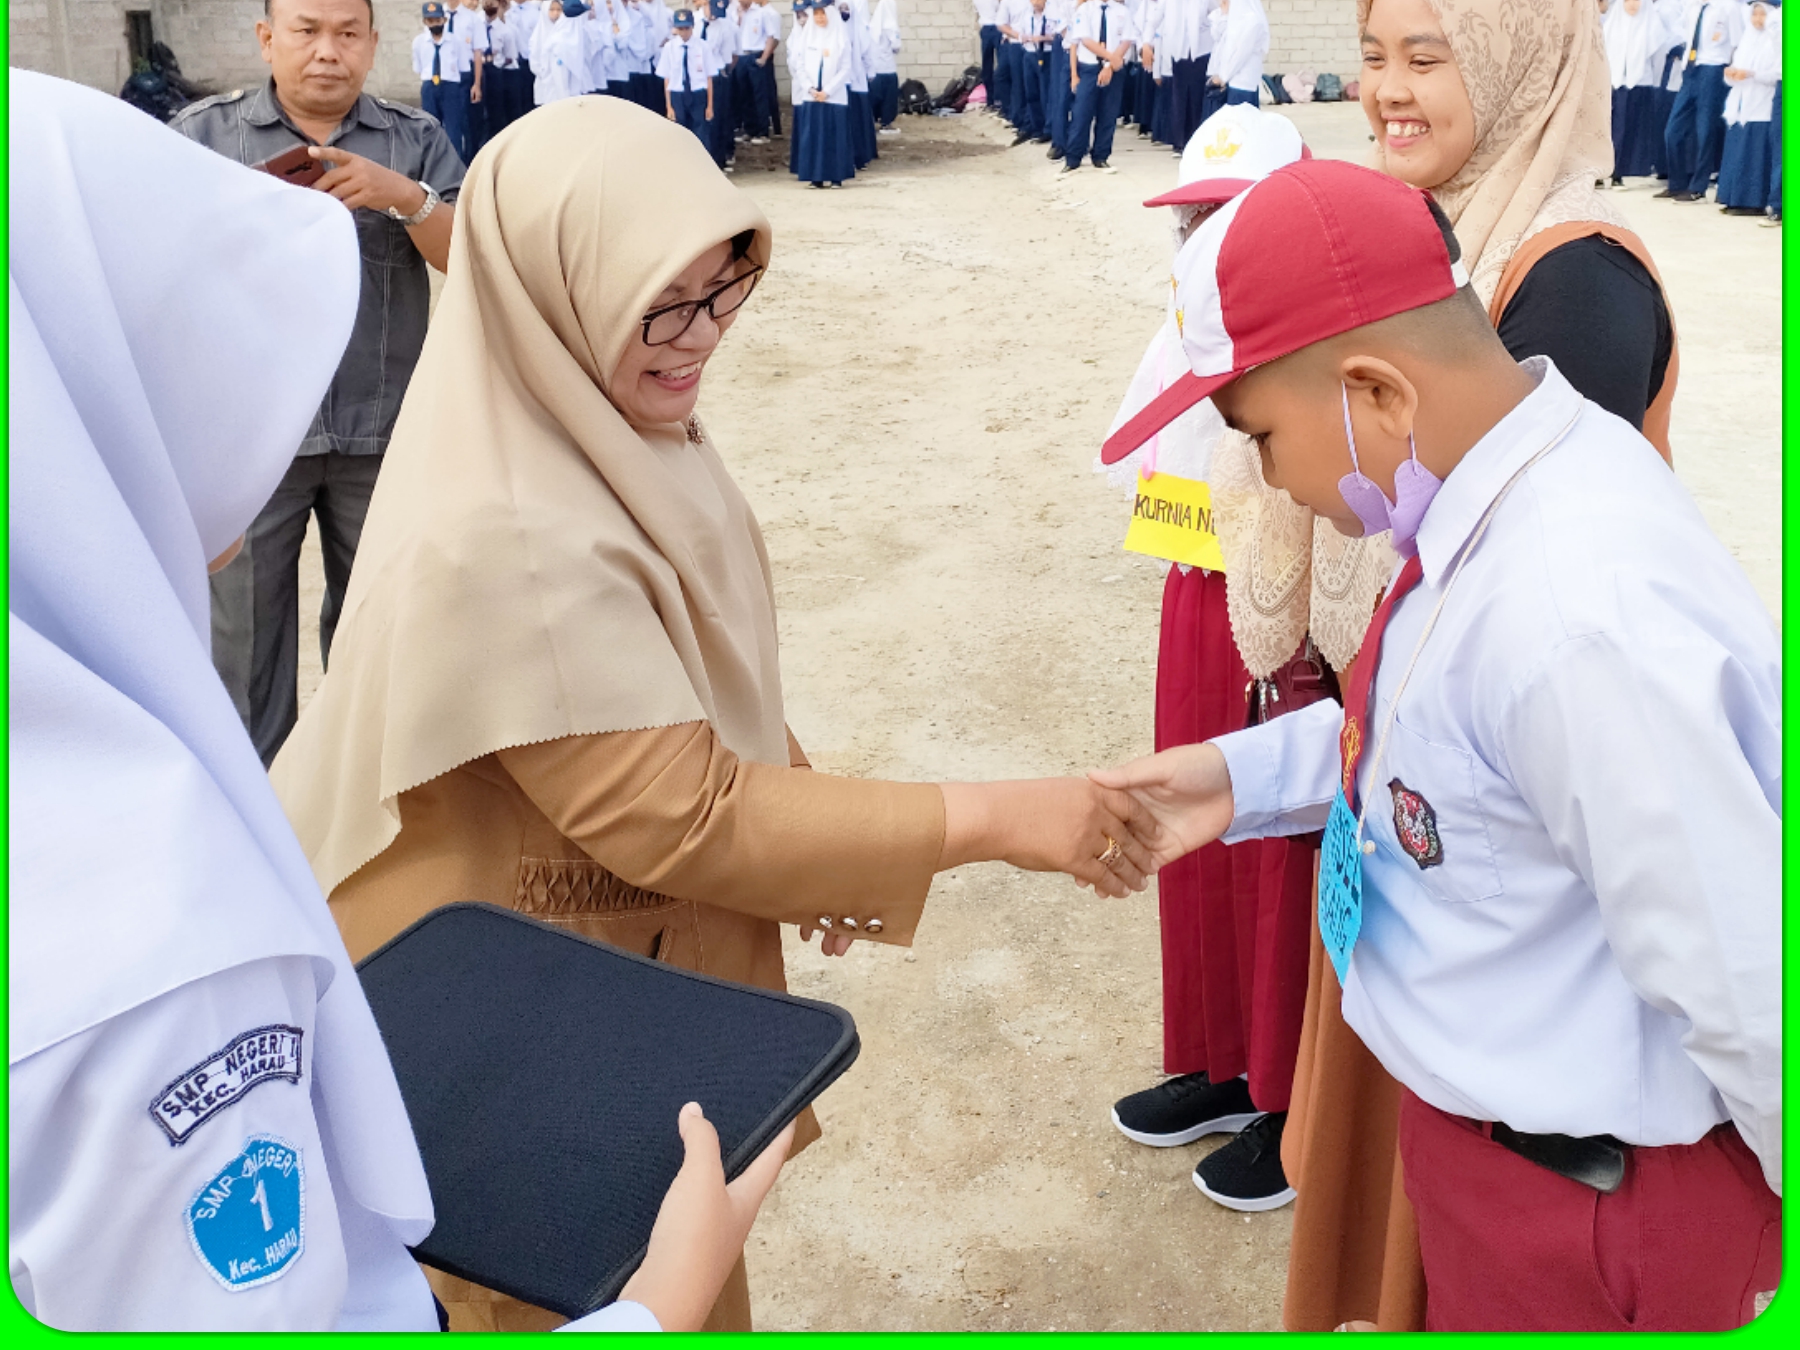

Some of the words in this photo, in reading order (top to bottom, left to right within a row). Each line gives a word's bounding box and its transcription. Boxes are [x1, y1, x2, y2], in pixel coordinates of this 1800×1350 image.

[1133, 492, 1192, 530] KURNIA
[162, 1073, 210, 1119] SMP
[225, 1034, 285, 1075] NEGERI
[240, 1055, 286, 1084] HARAU
[198, 1175, 234, 1219] SMP
[250, 1179, 274, 1232] 1
[264, 1227, 297, 1267] HARAU
